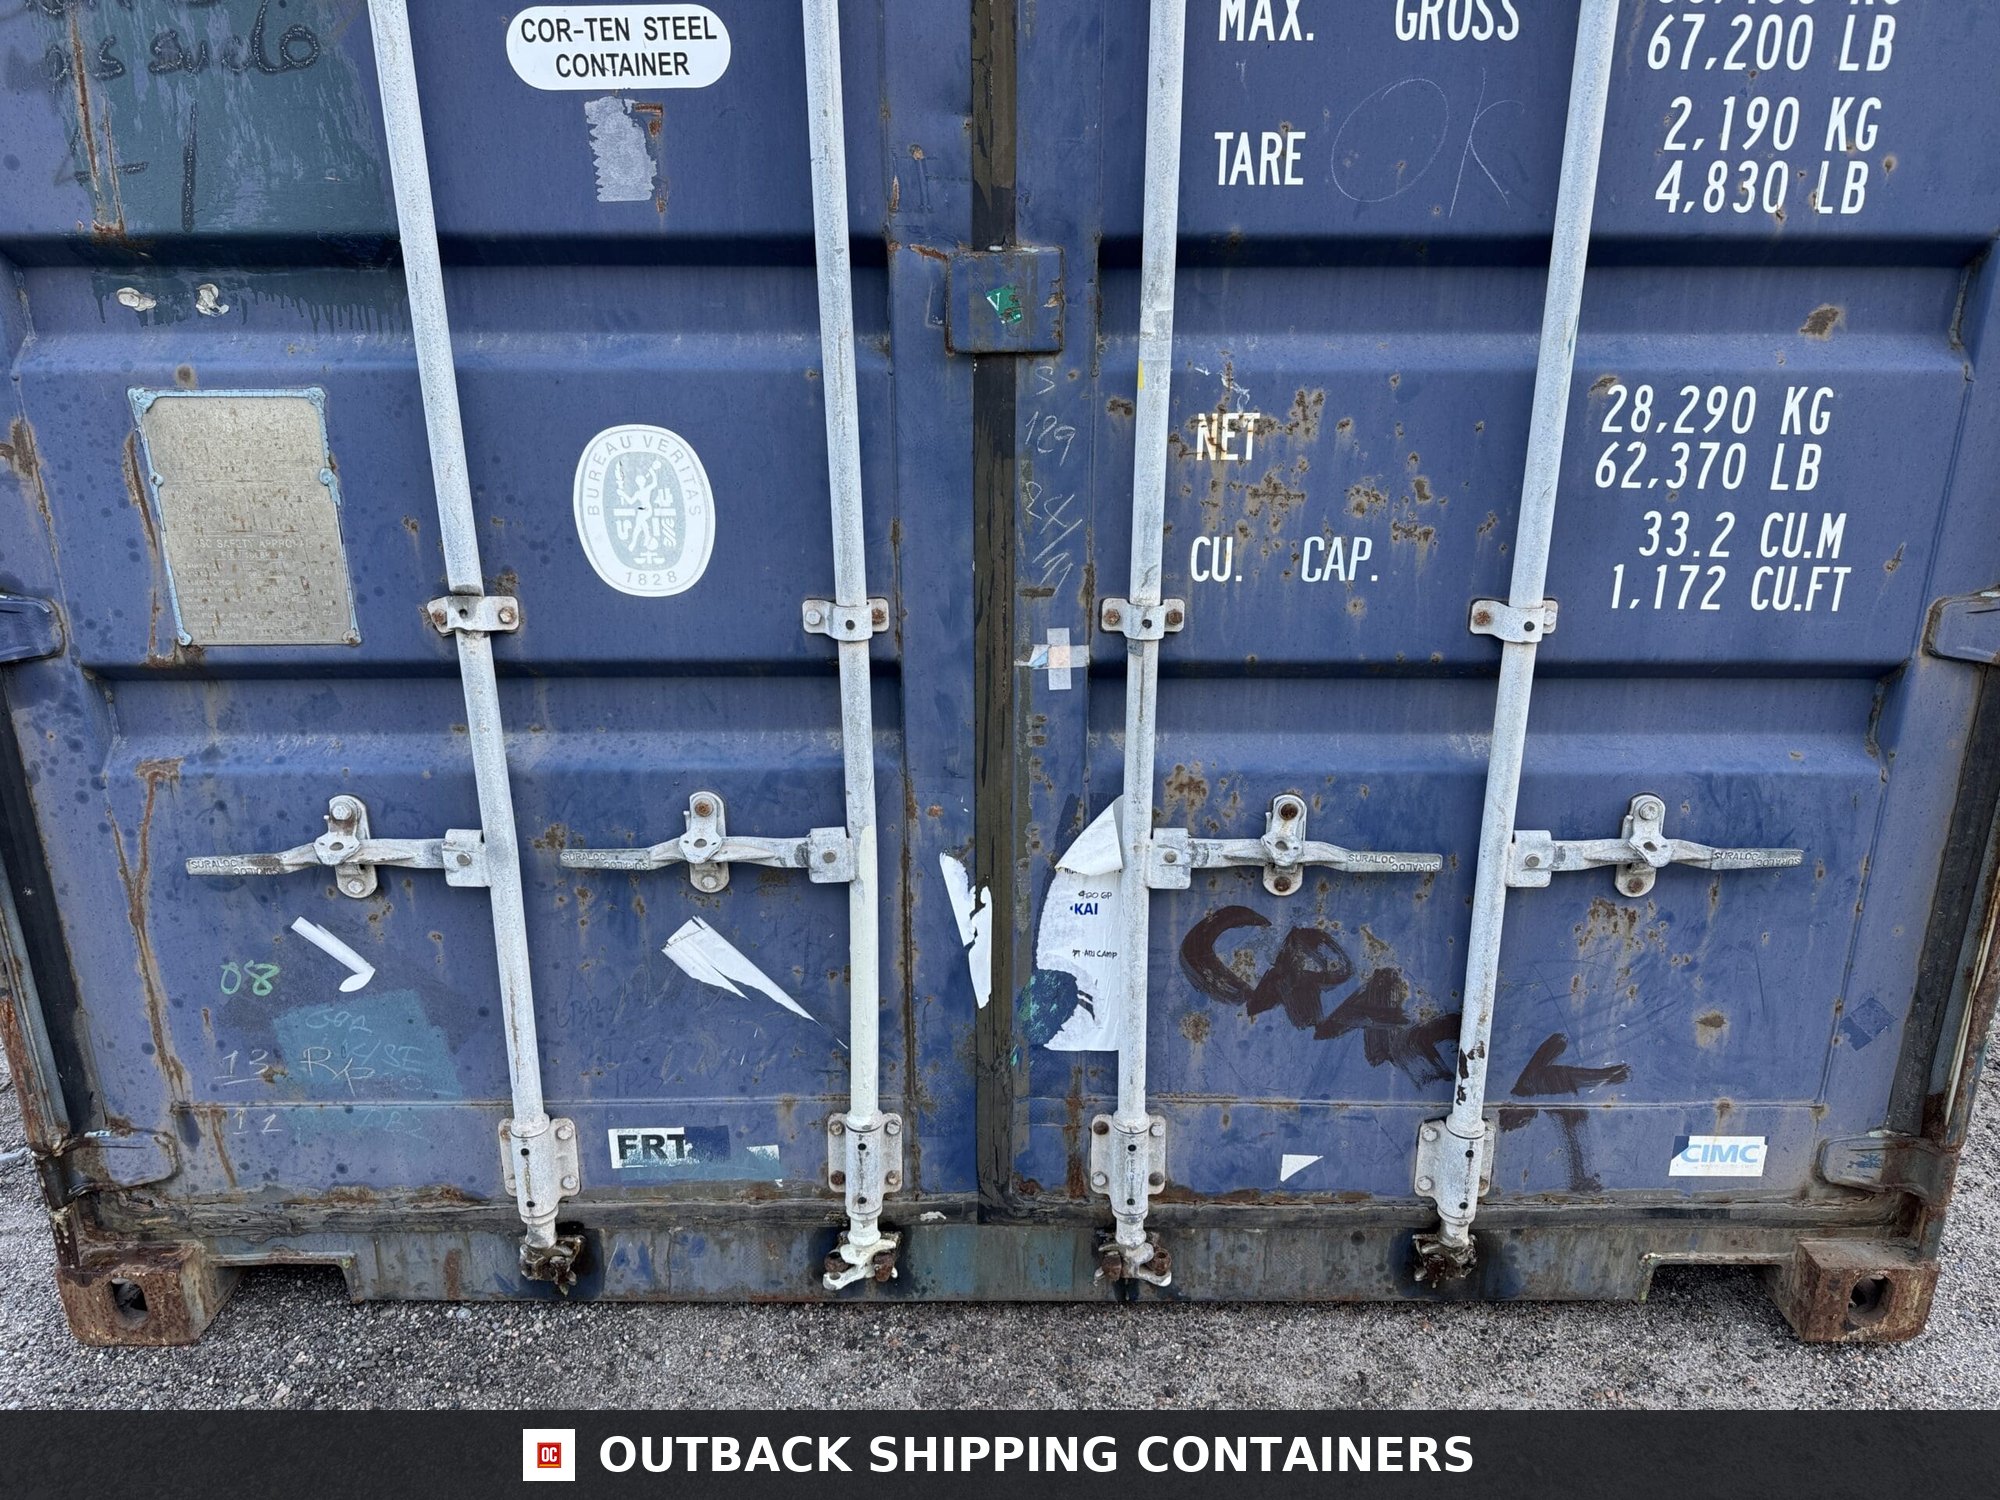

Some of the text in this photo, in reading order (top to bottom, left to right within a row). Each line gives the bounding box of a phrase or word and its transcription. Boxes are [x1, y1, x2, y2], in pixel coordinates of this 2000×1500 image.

[521, 16, 718, 43] COR-TEN STEEL
[1218, 0, 1519, 41] MAX. GROSS
[1647, 13, 1896, 71] 67,200 LB
[556, 52, 690, 78] CONTAINER
[1663, 96, 1882, 151] 2,190 KG
[1214, 131, 1306, 186] TARE
[1654, 159, 1869, 214] 4,830 LB
[1601, 384, 1834, 435] 28,290 KG
[1196, 412, 1261, 461] NET
[587, 435, 701, 516] BUREAU VERITAS
[1594, 441, 1822, 491] 62,370 LB
[1190, 536, 1379, 582] CU. CAP.
[1638, 510, 1847, 559] 33.2 CU.M
[625, 570, 678, 586] 1828
[1611, 563, 1852, 612] 1,172 CU.FT
[1348, 853, 1396, 864] SURALOC
[1680, 1144, 1760, 1163] CIMC
